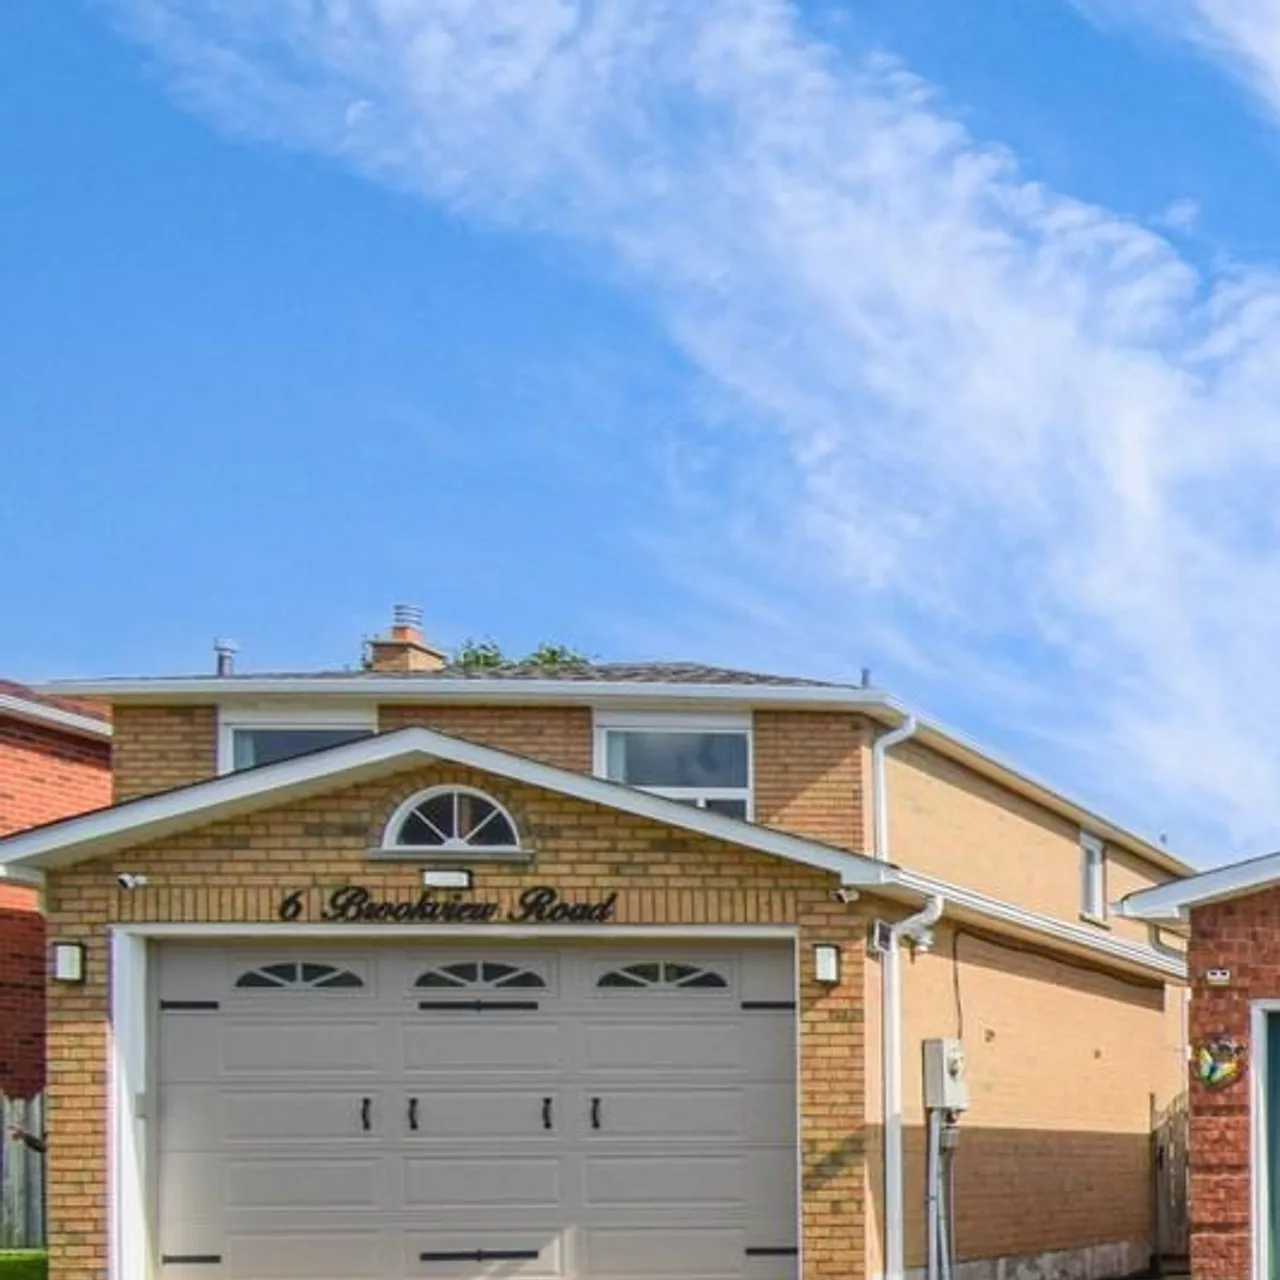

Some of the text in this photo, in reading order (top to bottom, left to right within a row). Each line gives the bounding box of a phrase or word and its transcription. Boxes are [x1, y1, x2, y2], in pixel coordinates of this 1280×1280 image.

[279, 886, 617, 922] 6 Brookview Road
